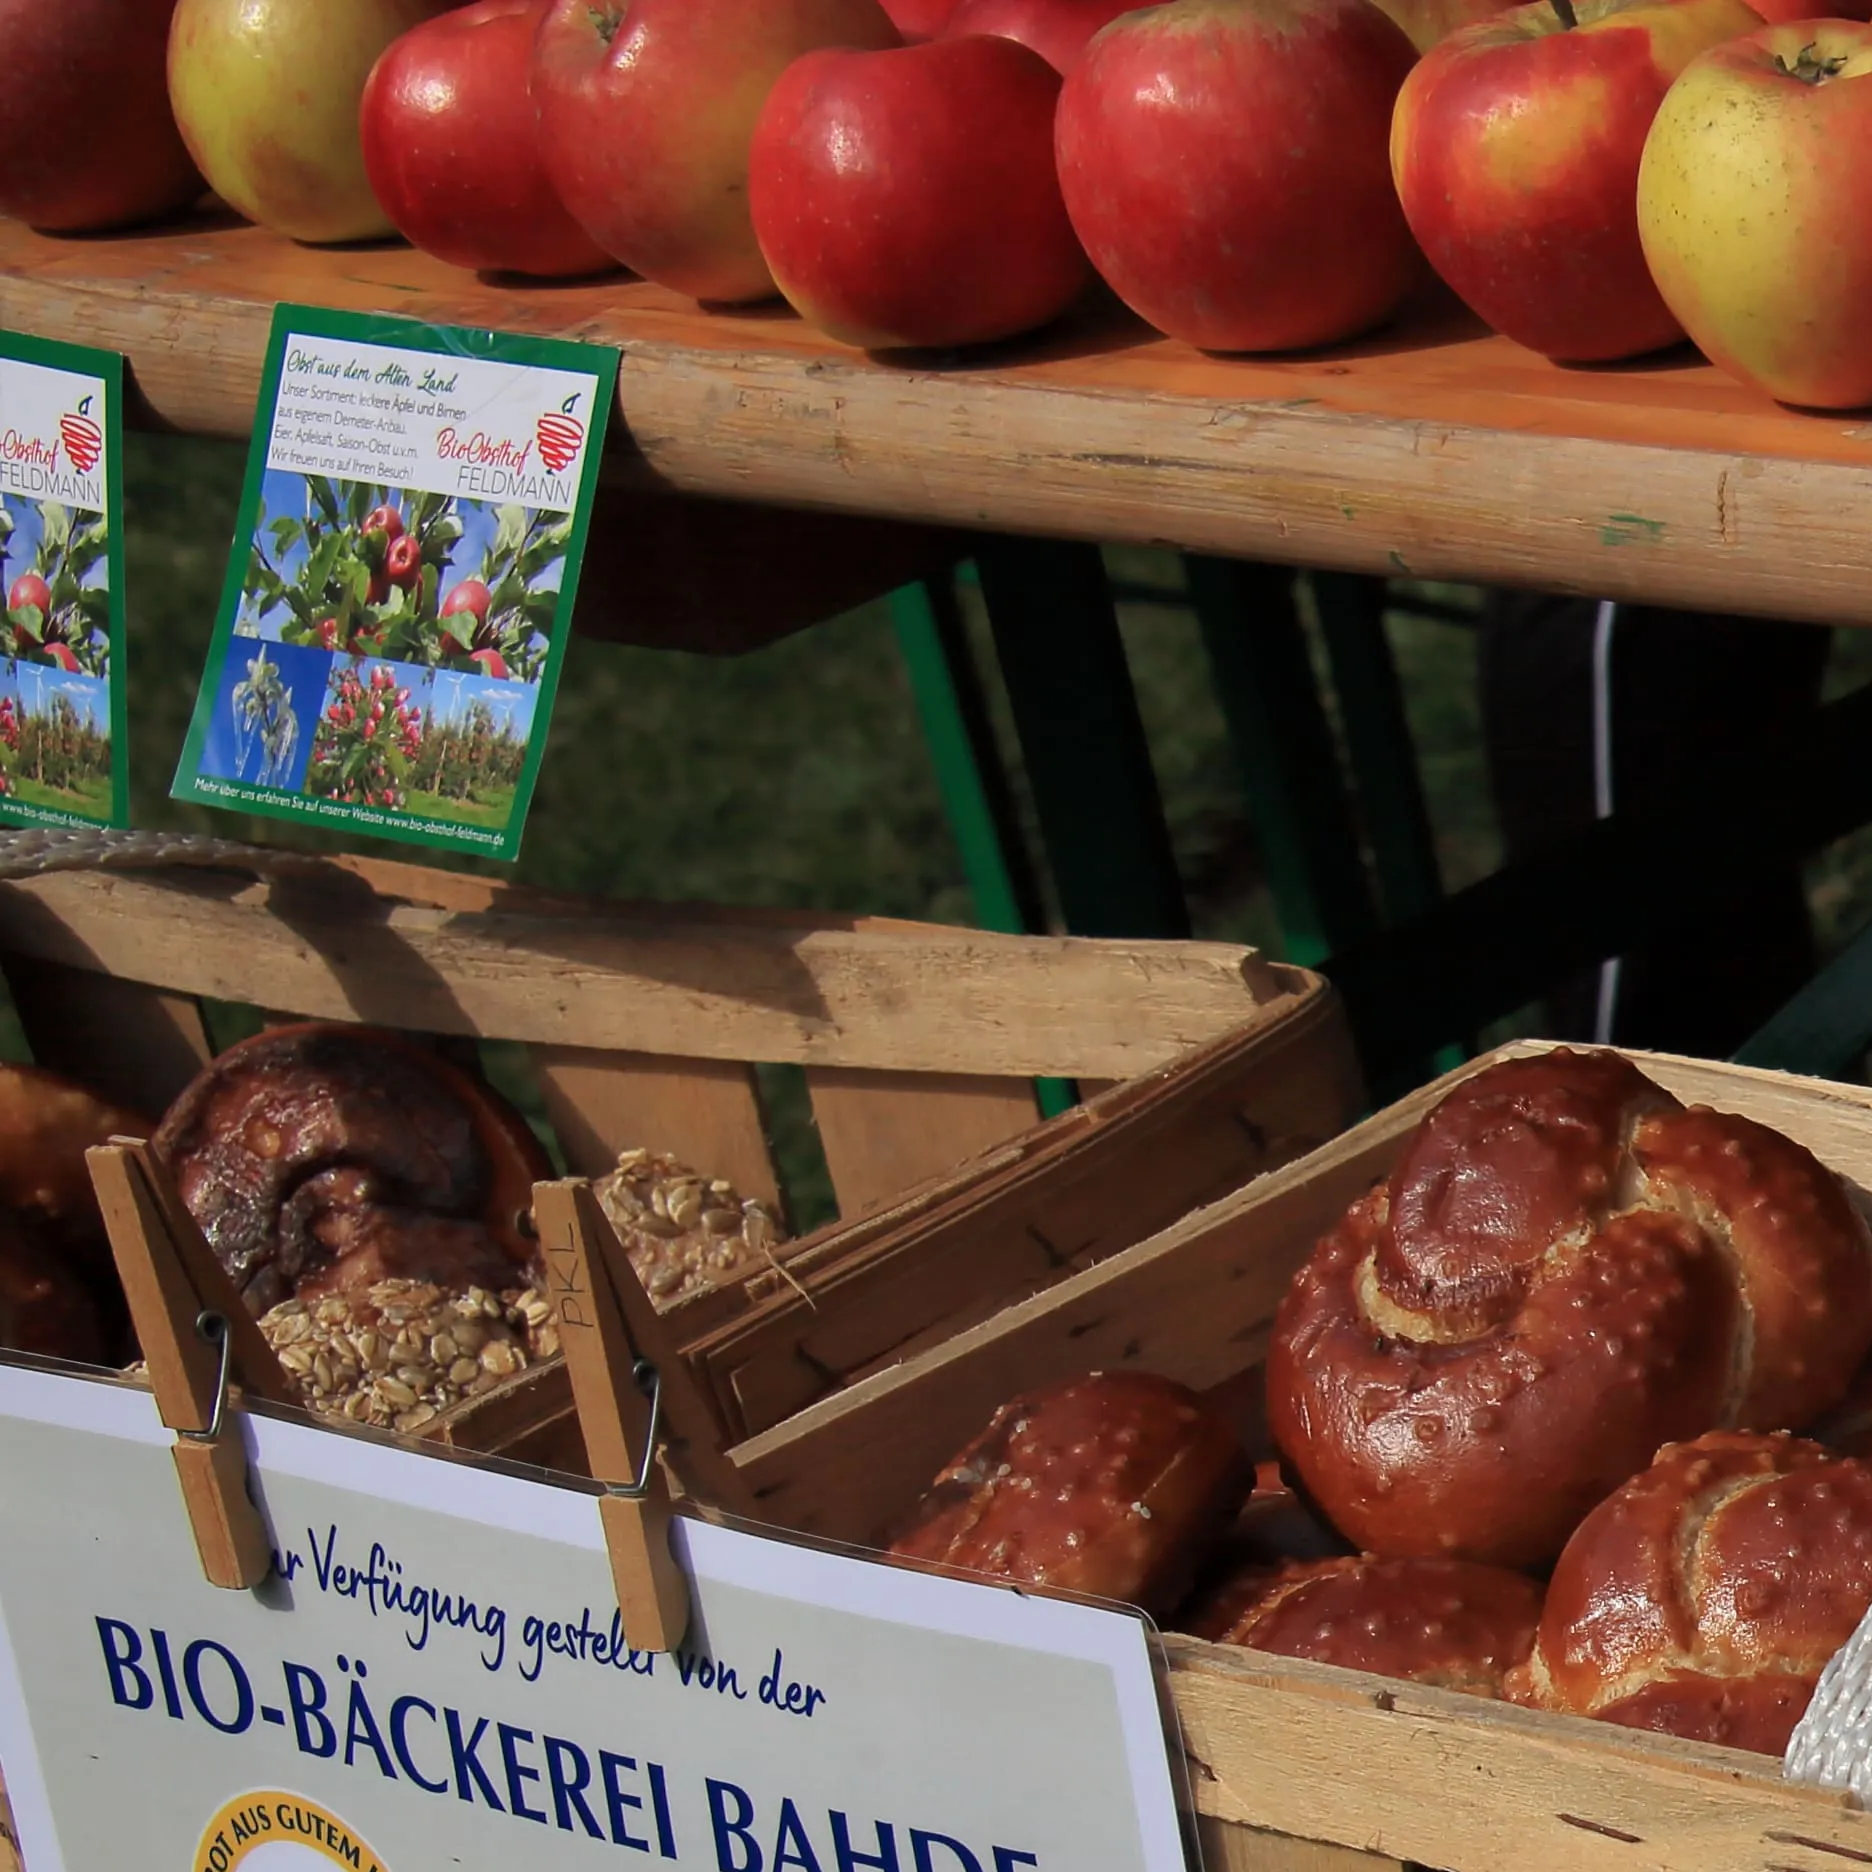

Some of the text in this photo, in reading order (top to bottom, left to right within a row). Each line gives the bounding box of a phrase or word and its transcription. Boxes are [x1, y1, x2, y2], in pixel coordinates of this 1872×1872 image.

[287, 350, 458, 396] Obst aus dem Alten Land
[278, 406, 407, 435] aus eigenem Demeter-Anbau.
[282, 381, 466, 421] Unser Sortiment: leckere Äpfel und Birnen
[0, 429, 59, 474] Obsthof
[272, 446, 413, 481] Wir freuen uns auf Ihren Besuch!
[337, 434, 390, 456] Saison-Obst
[393, 446, 418, 459] u.v.m.
[437, 427, 533, 476] BioObsthof
[0, 461, 100, 504] FELDMANN
[457, 466, 571, 504] FELDMANN
[194, 777, 219, 793] Mehr
[220, 781, 240, 798] über
[241, 788, 255, 801] uns
[256, 788, 290, 806] erfahren
[291, 796, 303, 809] Sie
[305, 798, 318, 812] auf
[319, 802, 350, 818] unserer
[352, 807, 384, 824] Website
[548, 1223, 594, 1327] PKL
[307, 1524, 506, 1672] Verfügung
[677, 1649, 747, 1699] von
[758, 1648, 826, 1717] der
[95, 1616, 677, 1859] BIO-BÄCKEREI
[231, 1803, 272, 1844] AUS
[276, 1803, 361, 1869] GUTEM
